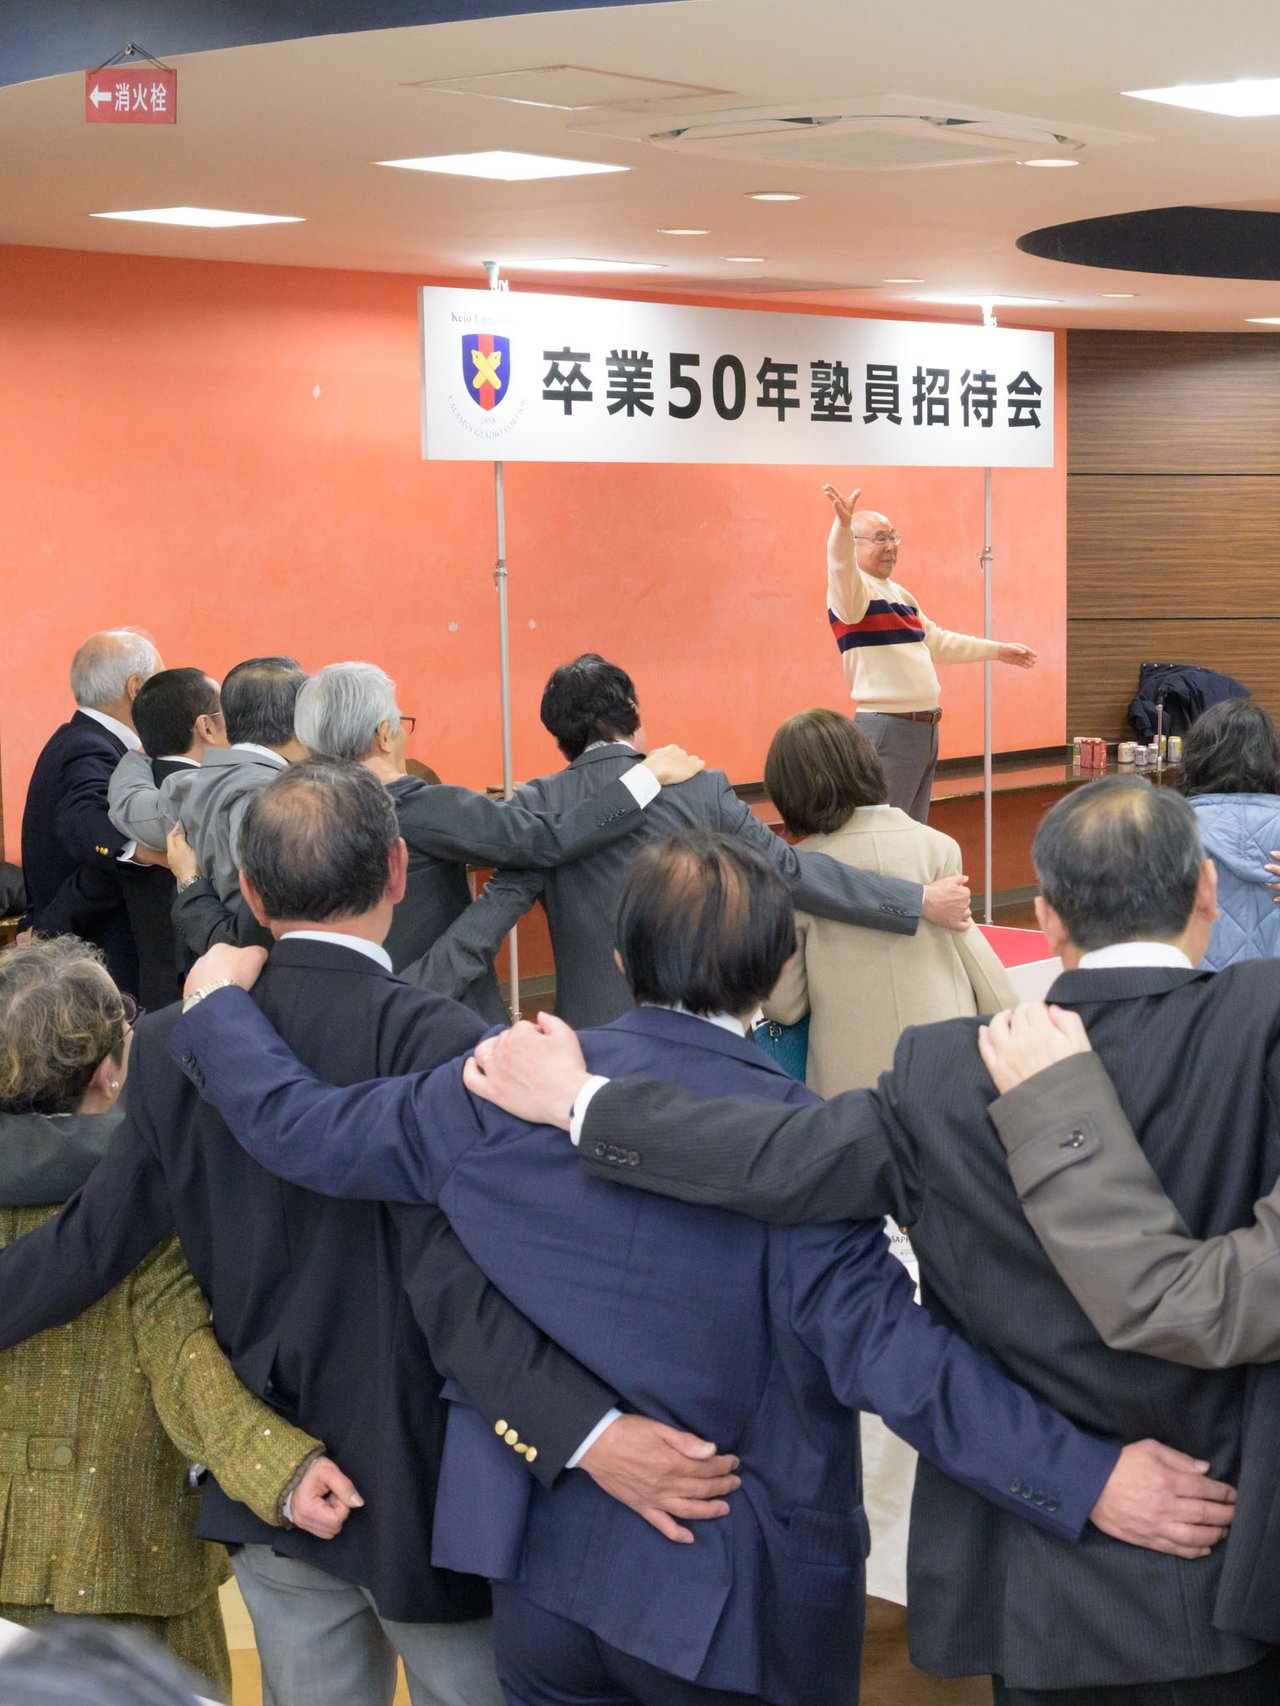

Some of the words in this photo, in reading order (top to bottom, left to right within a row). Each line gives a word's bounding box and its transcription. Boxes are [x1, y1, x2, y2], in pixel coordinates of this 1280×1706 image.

[114, 82, 167, 112] 消火栓
[451, 311, 472, 323] Keio
[541, 345, 1044, 430] 卒業50年塾員招待会
